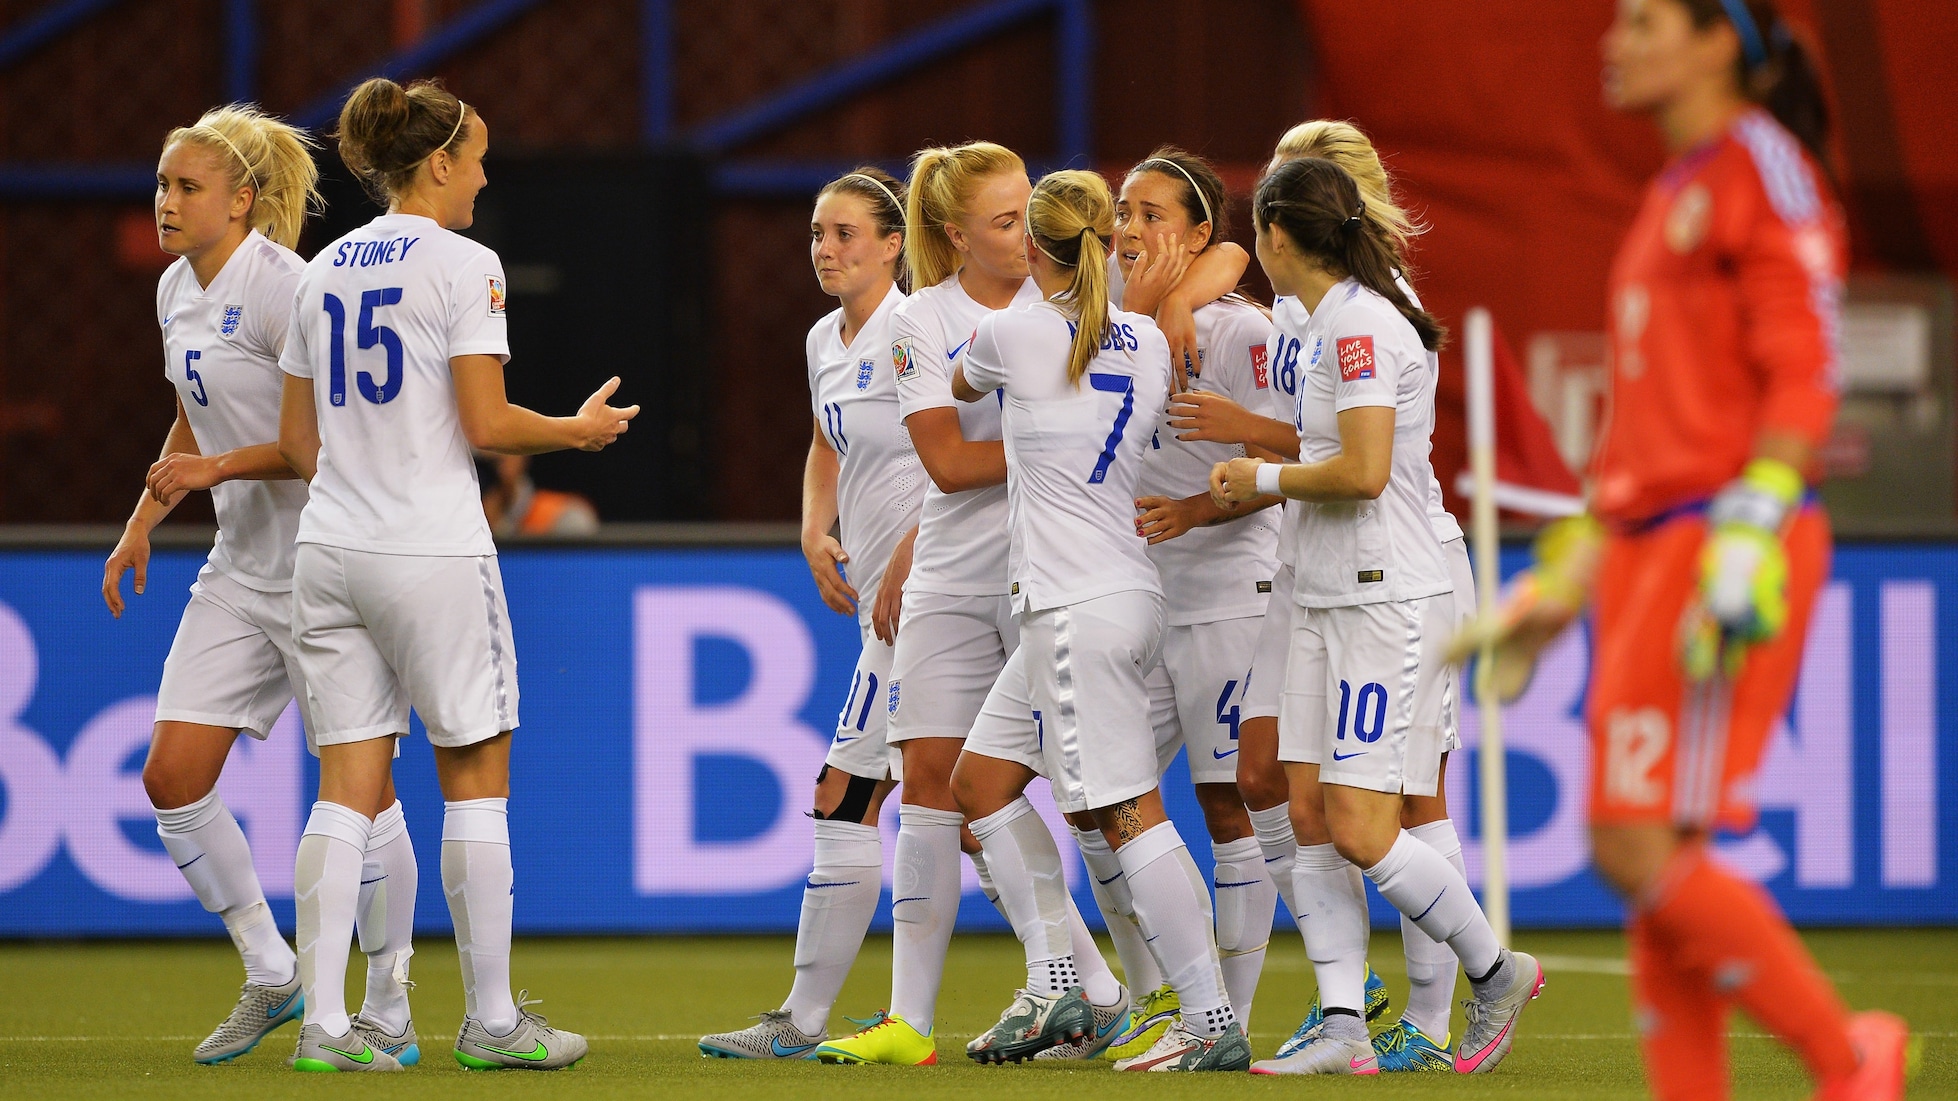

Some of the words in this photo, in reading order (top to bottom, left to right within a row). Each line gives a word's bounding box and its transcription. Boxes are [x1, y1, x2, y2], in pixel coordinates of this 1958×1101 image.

[333, 237, 420, 268] STONEY
[323, 287, 403, 407] 15
[1273, 333, 1300, 396] 18
[1340, 340, 1361, 357] LIVE
[1341, 348, 1370, 367] YOUR
[1343, 355, 1373, 378] GOALS
[185, 350, 209, 407] 5
[824, 402, 849, 456] 11
[1087, 373, 1134, 485] 7
[842, 669, 878, 732] 11
[1216, 680, 1241, 740] 4
[1336, 679, 1388, 743] 10
[1605, 706, 1670, 806] 12
